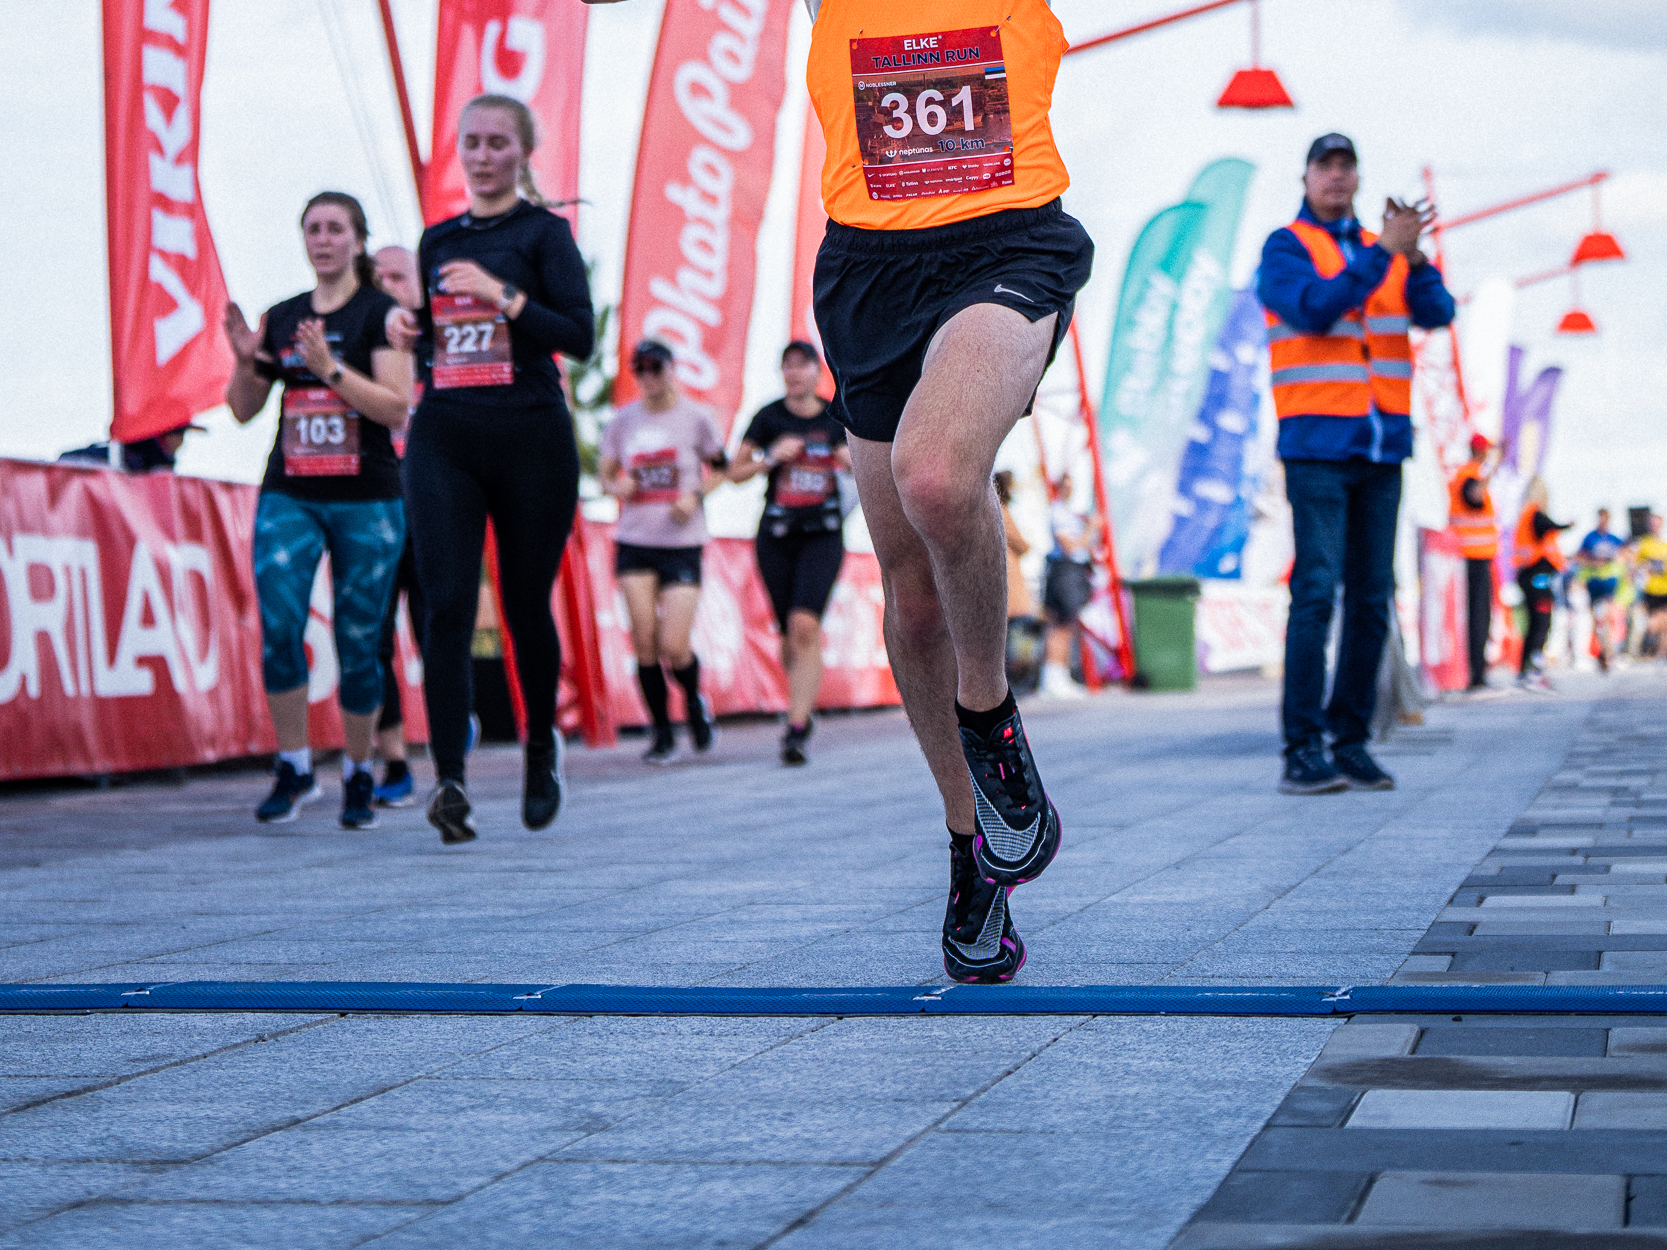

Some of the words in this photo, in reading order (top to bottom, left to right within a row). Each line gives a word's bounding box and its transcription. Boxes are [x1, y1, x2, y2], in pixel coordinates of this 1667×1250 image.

[903, 36, 939, 50] ELKE
[871, 51, 941, 69] TALLINN
[944, 46, 980, 62] RUN
[880, 85, 975, 139] 361
[937, 138, 956, 152] 10
[960, 137, 986, 150] km
[443, 321, 494, 354] 227
[295, 414, 346, 444] 103
